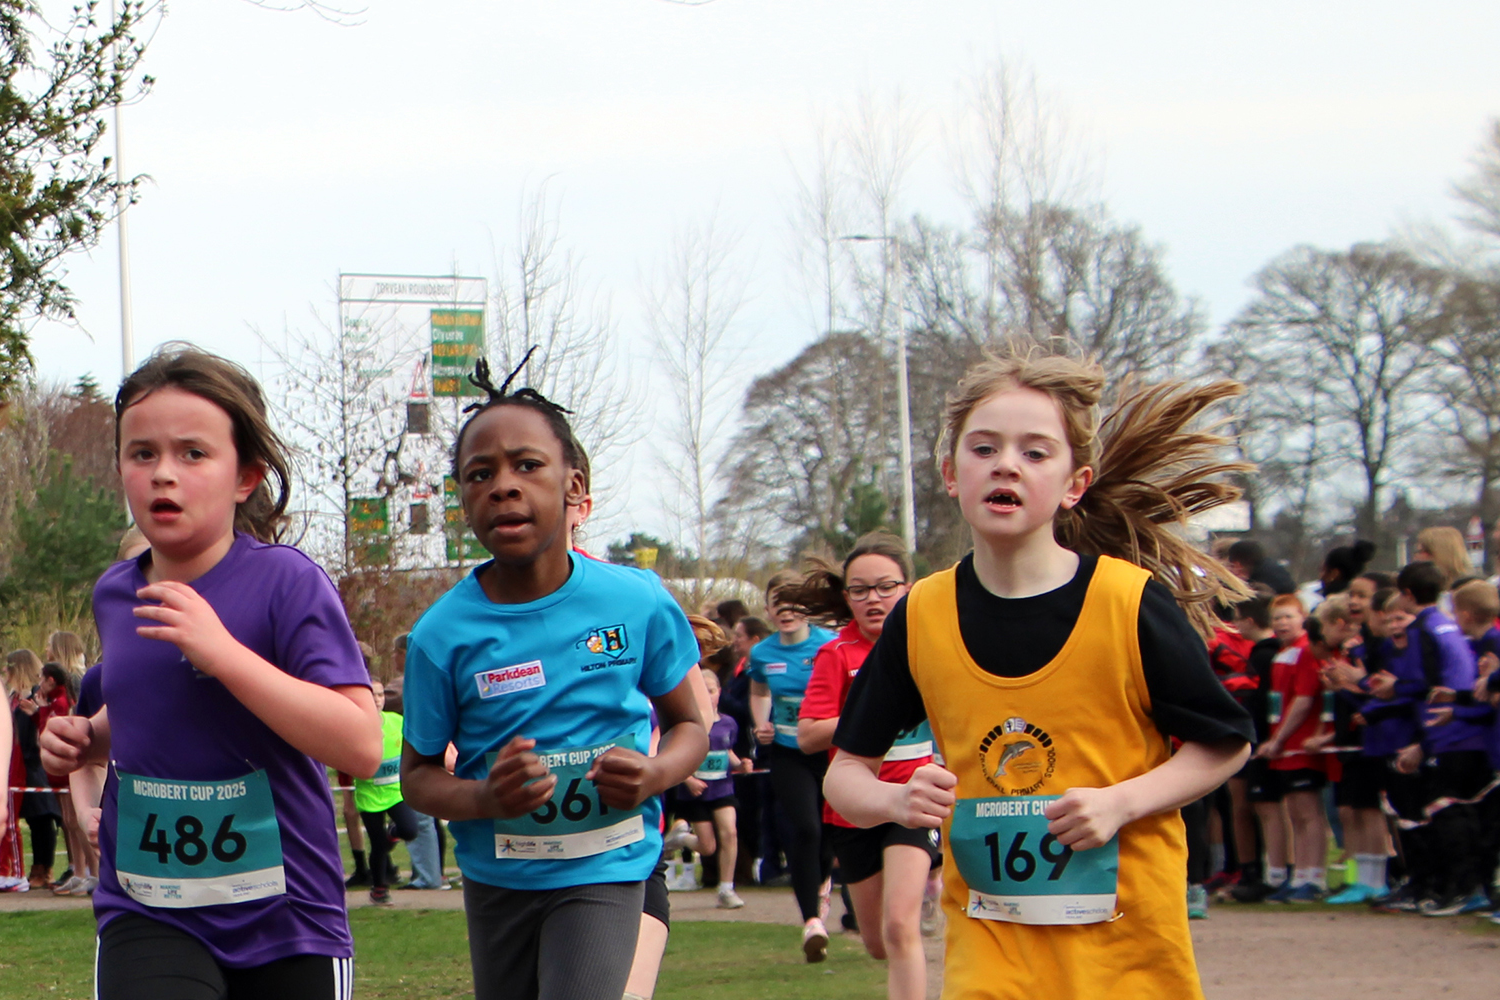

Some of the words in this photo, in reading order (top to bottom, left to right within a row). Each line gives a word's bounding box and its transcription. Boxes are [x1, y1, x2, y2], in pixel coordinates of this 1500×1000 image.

[580, 662, 606, 672] HILTON
[607, 657, 637, 667] PRIMARY
[488, 666, 540, 684] Parkdean
[492, 676, 540, 690] Resorts
[569, 750, 591, 766] CUP
[133, 779, 188, 800] MCROBERT
[189, 785, 214, 801] CUP
[217, 781, 247, 800] 2025
[976, 800, 1030, 818] MCROBERT
[139, 813, 247, 866] 486
[984, 831, 1074, 882] 169
